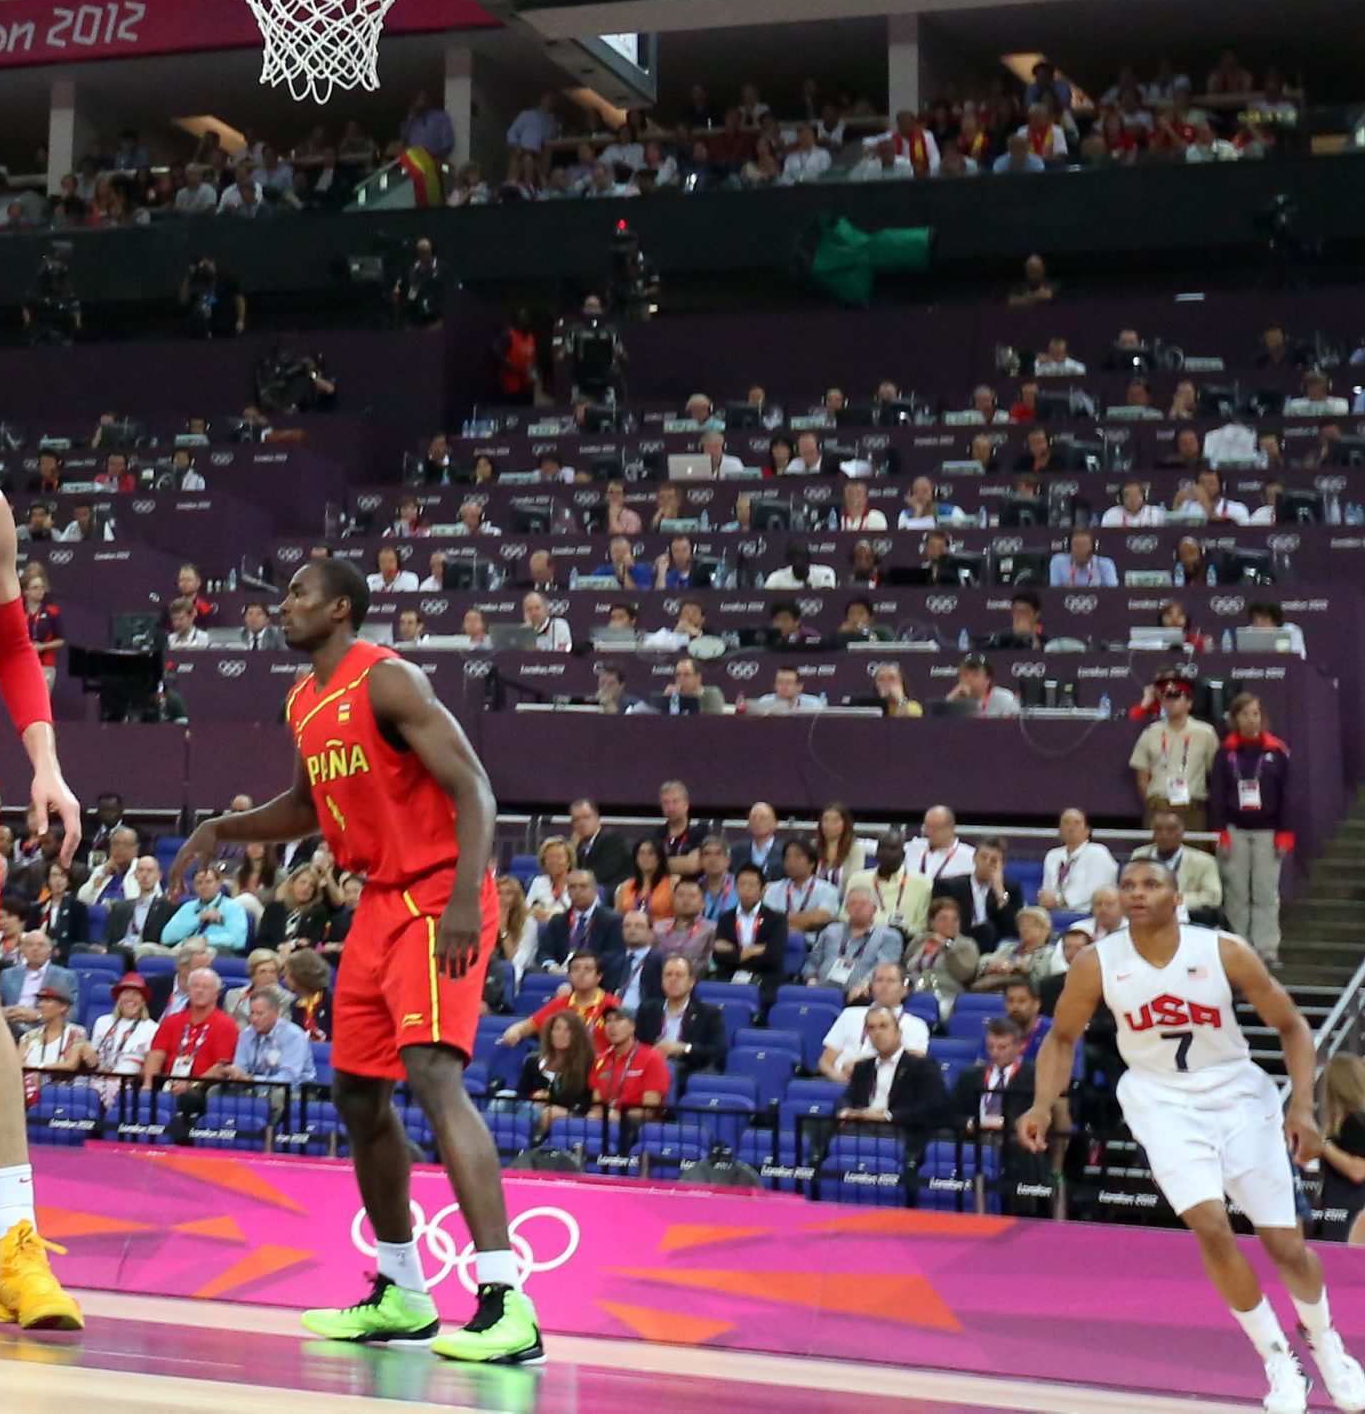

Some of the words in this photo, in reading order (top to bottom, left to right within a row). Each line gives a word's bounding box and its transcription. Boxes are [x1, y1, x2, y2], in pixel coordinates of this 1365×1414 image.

[46, 1, 147, 48] 2012
[1123, 993, 1222, 1032] USA
[1160, 1031, 1194, 1073] 7
